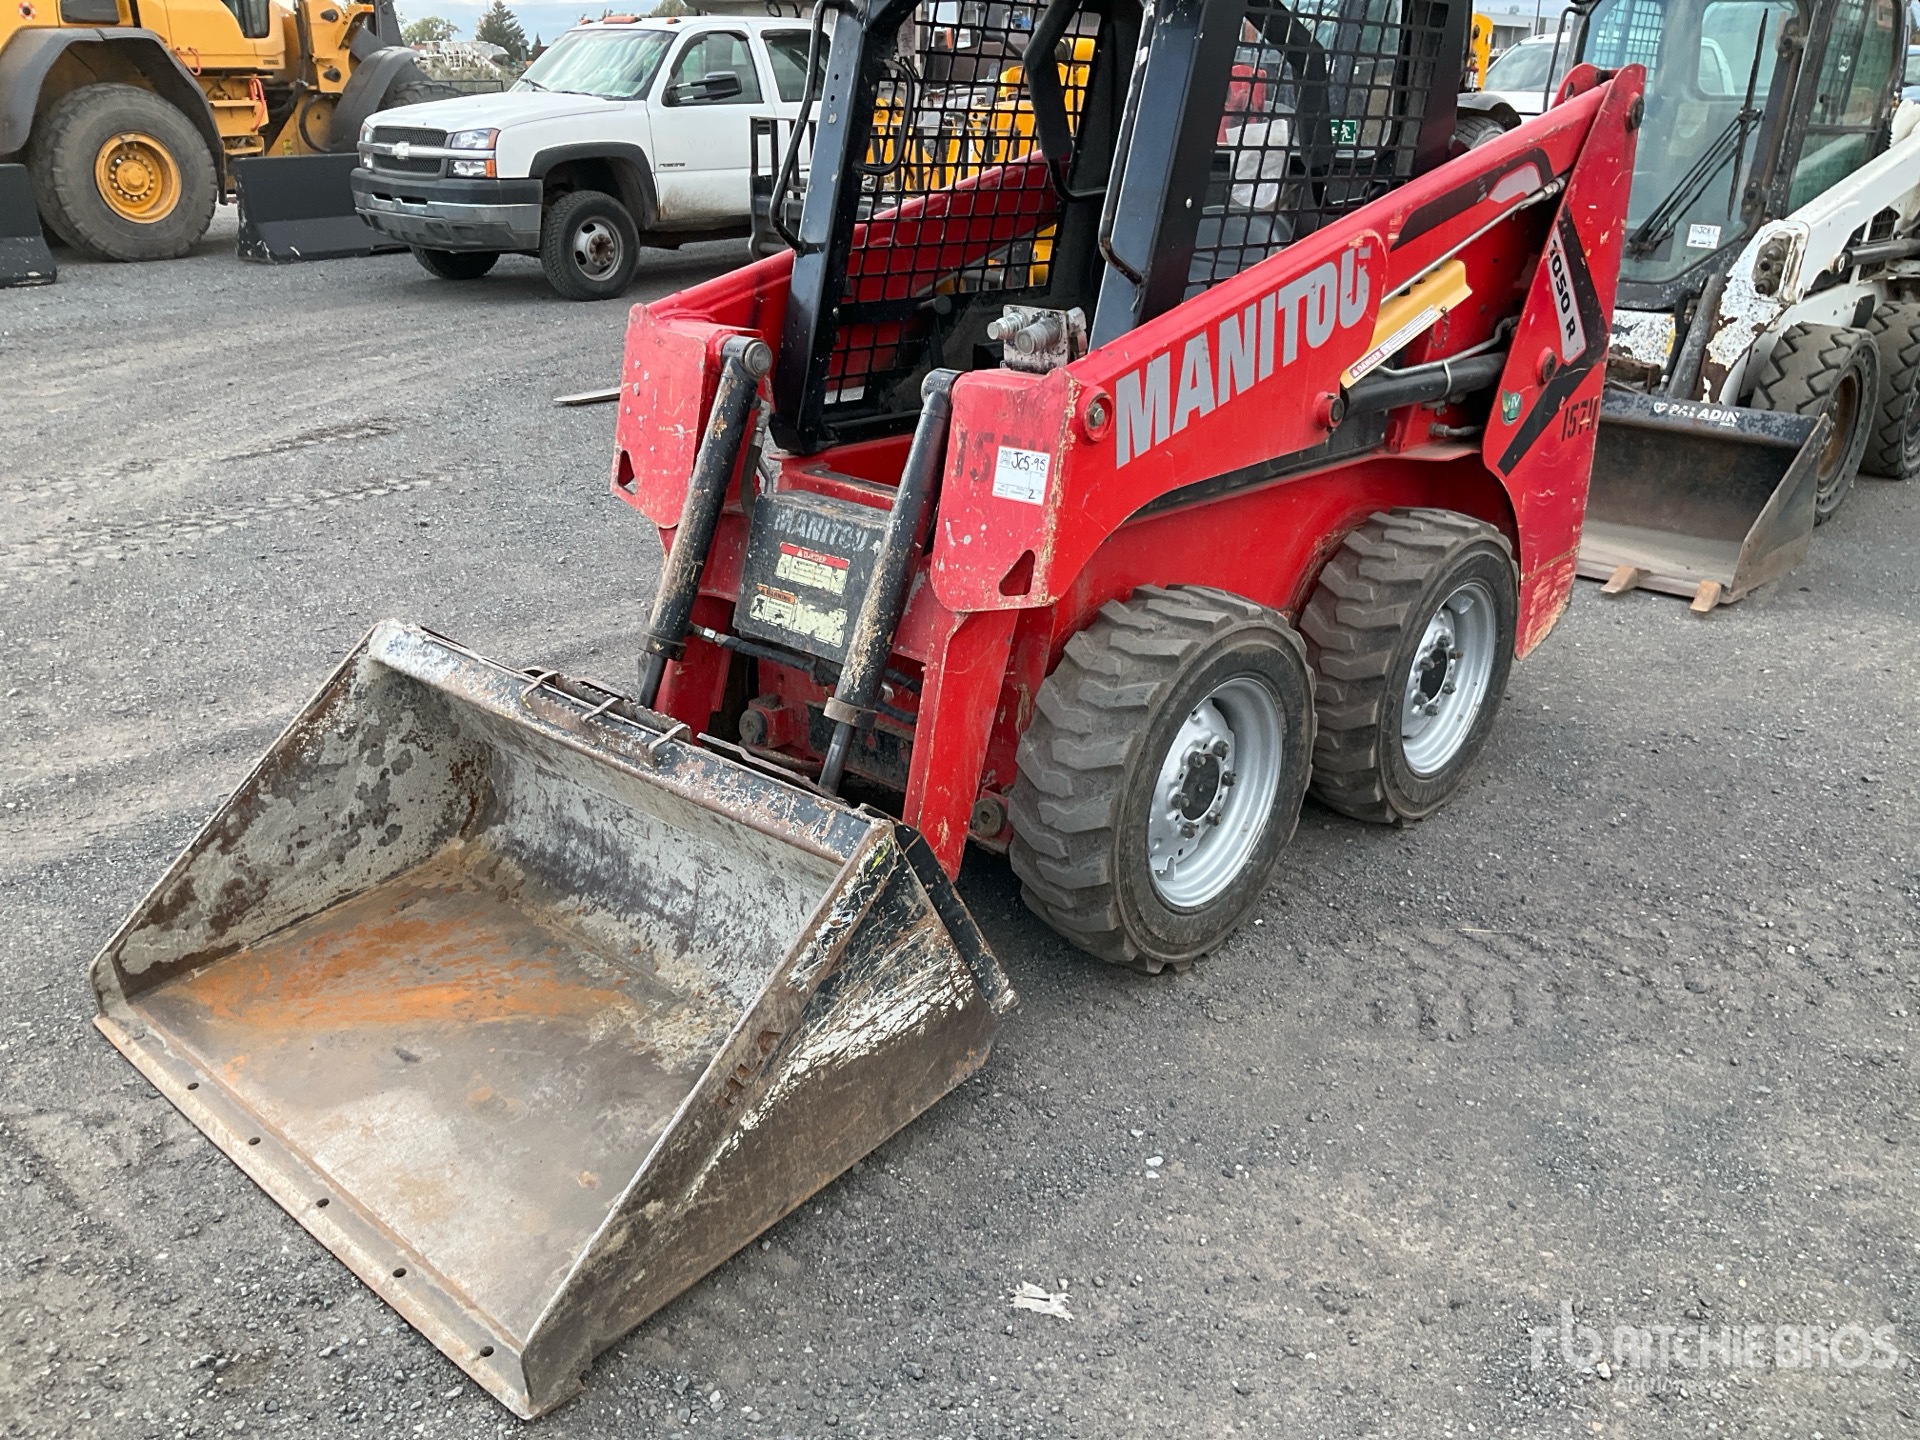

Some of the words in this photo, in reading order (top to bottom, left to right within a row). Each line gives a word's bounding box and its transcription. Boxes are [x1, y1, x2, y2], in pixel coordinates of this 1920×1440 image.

[1116, 246, 1372, 470] MANITOU
[1356, 350, 1383, 373] DANGER
[1028, 489, 1036, 500] 2
